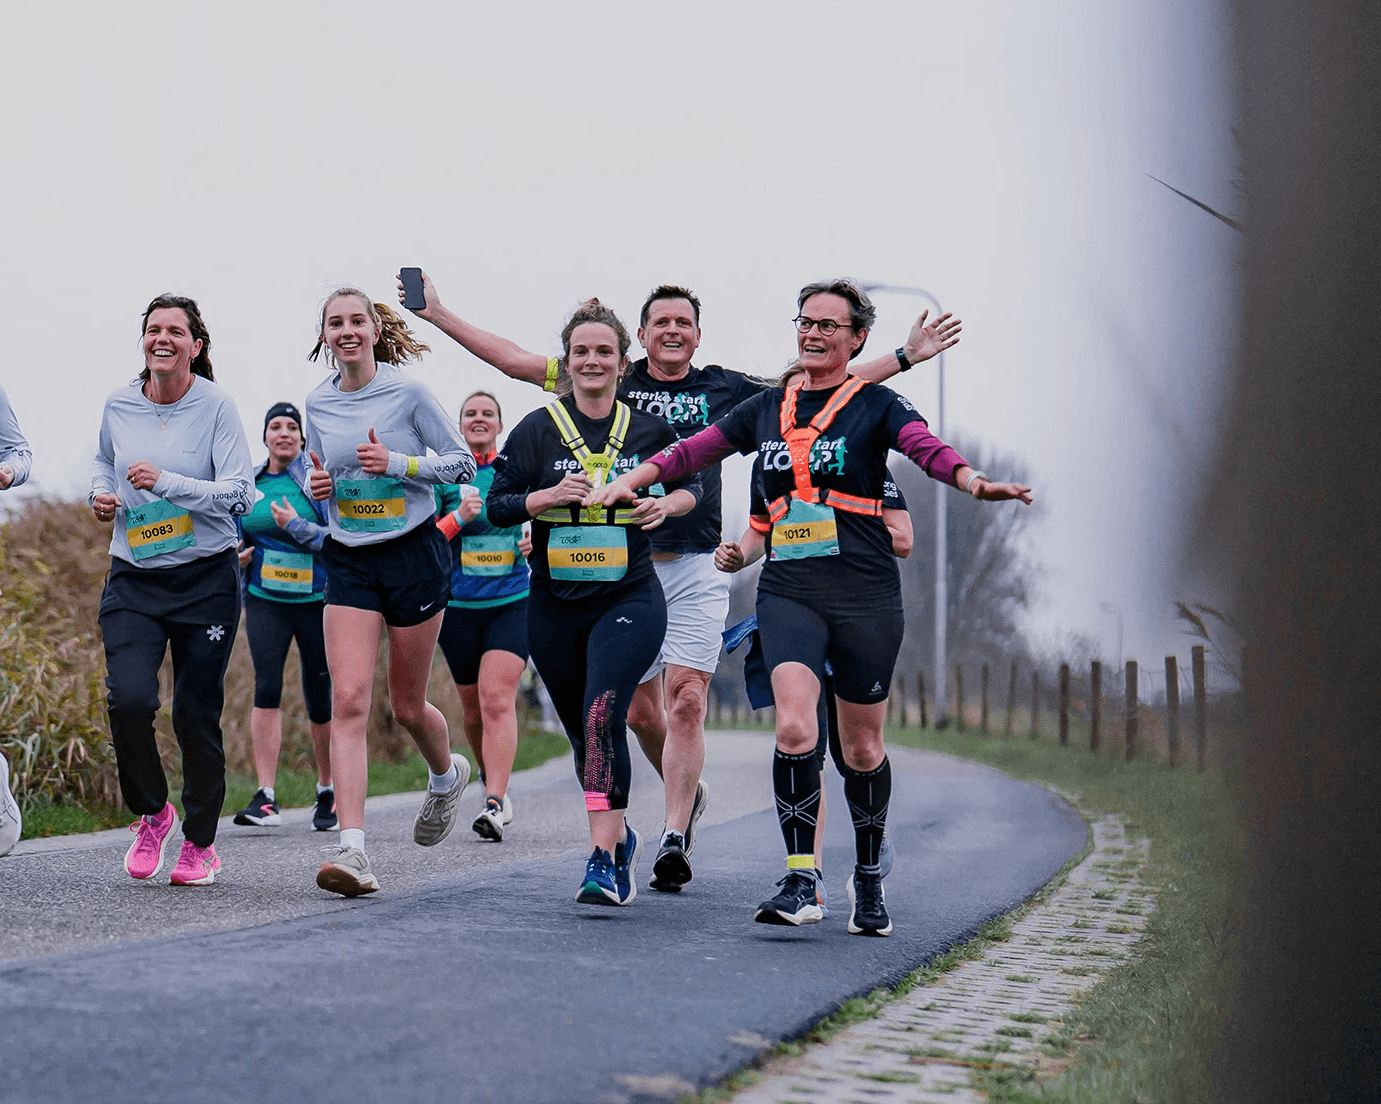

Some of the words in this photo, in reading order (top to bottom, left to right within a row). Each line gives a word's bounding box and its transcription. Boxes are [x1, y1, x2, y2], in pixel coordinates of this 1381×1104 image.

[352, 504, 385, 514] 10022
[140, 523, 174, 540] 10083
[784, 527, 811, 540] 10121
[569, 552, 606, 563] 10016
